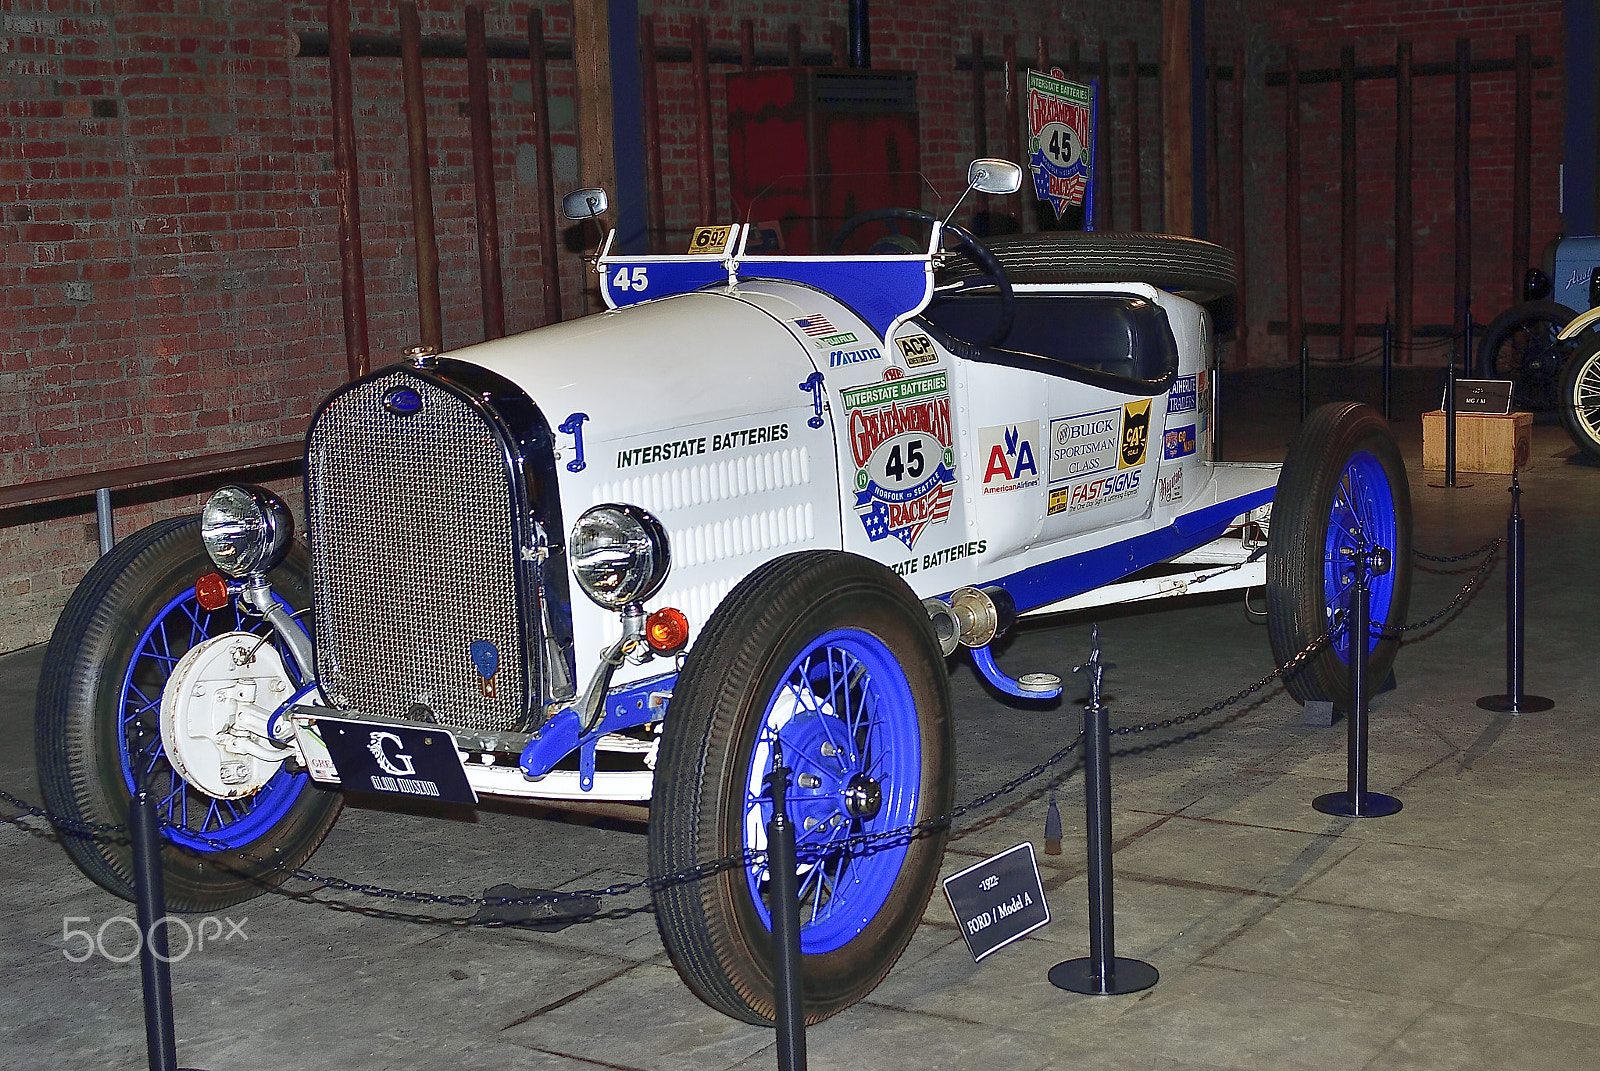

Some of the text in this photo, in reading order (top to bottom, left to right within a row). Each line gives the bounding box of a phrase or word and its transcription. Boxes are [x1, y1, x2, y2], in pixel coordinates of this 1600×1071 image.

[1030, 77, 1088, 100] INTERSTATE BATTERIES
[1049, 130, 1072, 163] 45
[1049, 175, 1072, 199] RACE
[613, 267, 649, 292] 45
[901, 336, 932, 357] ACP
[885, 368, 904, 381] THE
[845, 376, 946, 407] INTERSTATE BATTERIES
[1070, 419, 1114, 439] BUICK
[1126, 425, 1145, 447] CAT
[1178, 430, 1187, 443] GO
[616, 423, 789, 469] INTERSTATE BATTERIES
[1053, 438, 1116, 461] SPORTSMAN
[885, 440, 925, 482] 45
[1068, 457, 1100, 474] CLASS
[859, 473, 867, 486] 19
[874, 486, 904, 501] NORFOLK
[913, 471, 940, 496] SEATTLE
[888, 496, 929, 529] RACE
[923, 539, 987, 570] BATTERIES
[367, 731, 416, 775] G
[397, 777, 440, 797] MUSEUM
[966, 911, 992, 935] FORD
[997, 894, 1024, 919] Model
[1024, 891, 1033, 907] A
